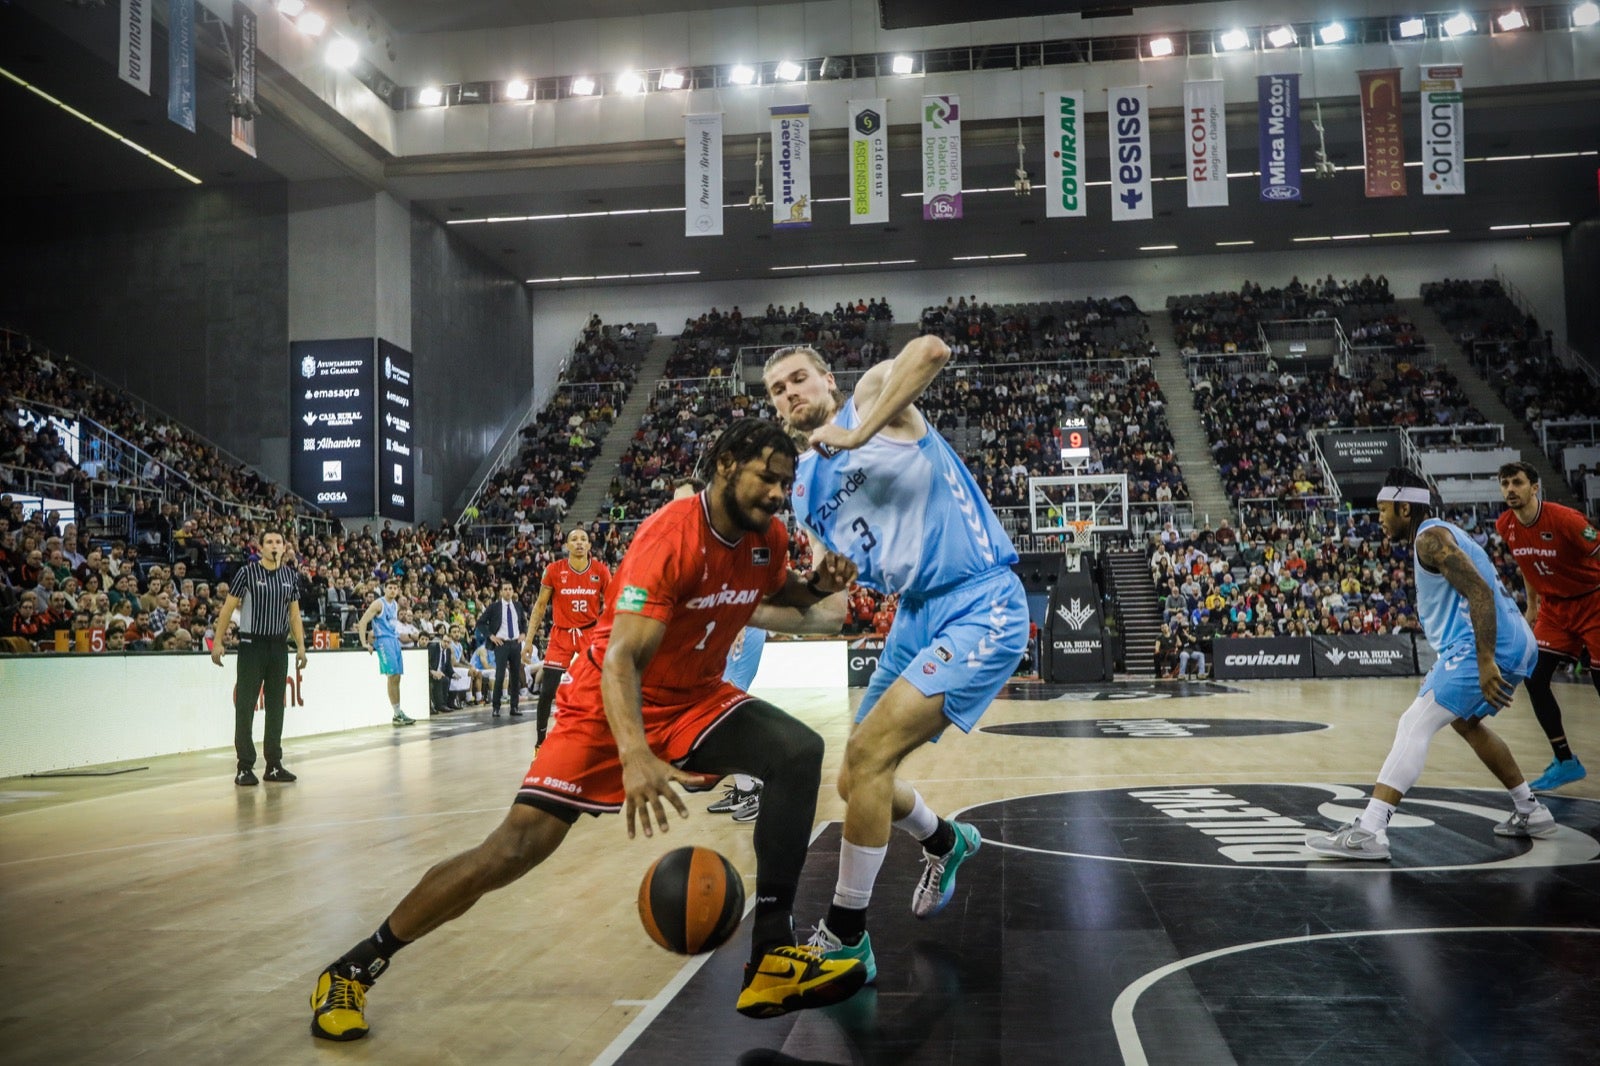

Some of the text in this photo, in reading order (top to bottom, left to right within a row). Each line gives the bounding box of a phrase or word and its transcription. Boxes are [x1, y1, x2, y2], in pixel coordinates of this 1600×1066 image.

[241, 14, 251, 99] BERNER
[1117, 97, 1143, 184] asisa
[1191, 108, 1207, 182] RICOH
[1268, 77, 1286, 185] Mica Motor
[1426, 104, 1452, 175] orion
[779, 120, 795, 204] aeroprint
[924, 137, 936, 188] Deportes
[938, 136, 949, 192] Palacio de
[1053, 96, 1078, 211] COVIRAN
[1375, 126, 1387, 177] PEREZ
[1387, 112, 1401, 191] ANTONIO
[855, 140, 867, 215] ASCENSORES
[934, 201, 953, 213] 16h
[313, 388, 360, 399] emasagra
[318, 411, 363, 421] CAJA RURAL
[1066, 418, 1085, 426] 4:54
[317, 436, 361, 450] Alhambra
[1070, 432, 1082, 448] 9
[1335, 440, 1388, 449] AYUNTAMIENTO
[1350, 448, 1383, 456] GRANADA
[816, 467, 868, 520] zunder
[852, 516, 877, 552] 3
[560, 585, 597, 596] COVIRAN
[685, 582, 759, 610] COVIRAN
[571, 599, 588, 612] 32
[91, 634, 104, 652] 5
[314, 633, 325, 650] 5
[694, 620, 716, 650] 1
[1053, 640, 1102, 649] CAJA RURAL
[1225, 650, 1300, 666] COVIRAN
[1347, 650, 1403, 660] CAJA RURAL
